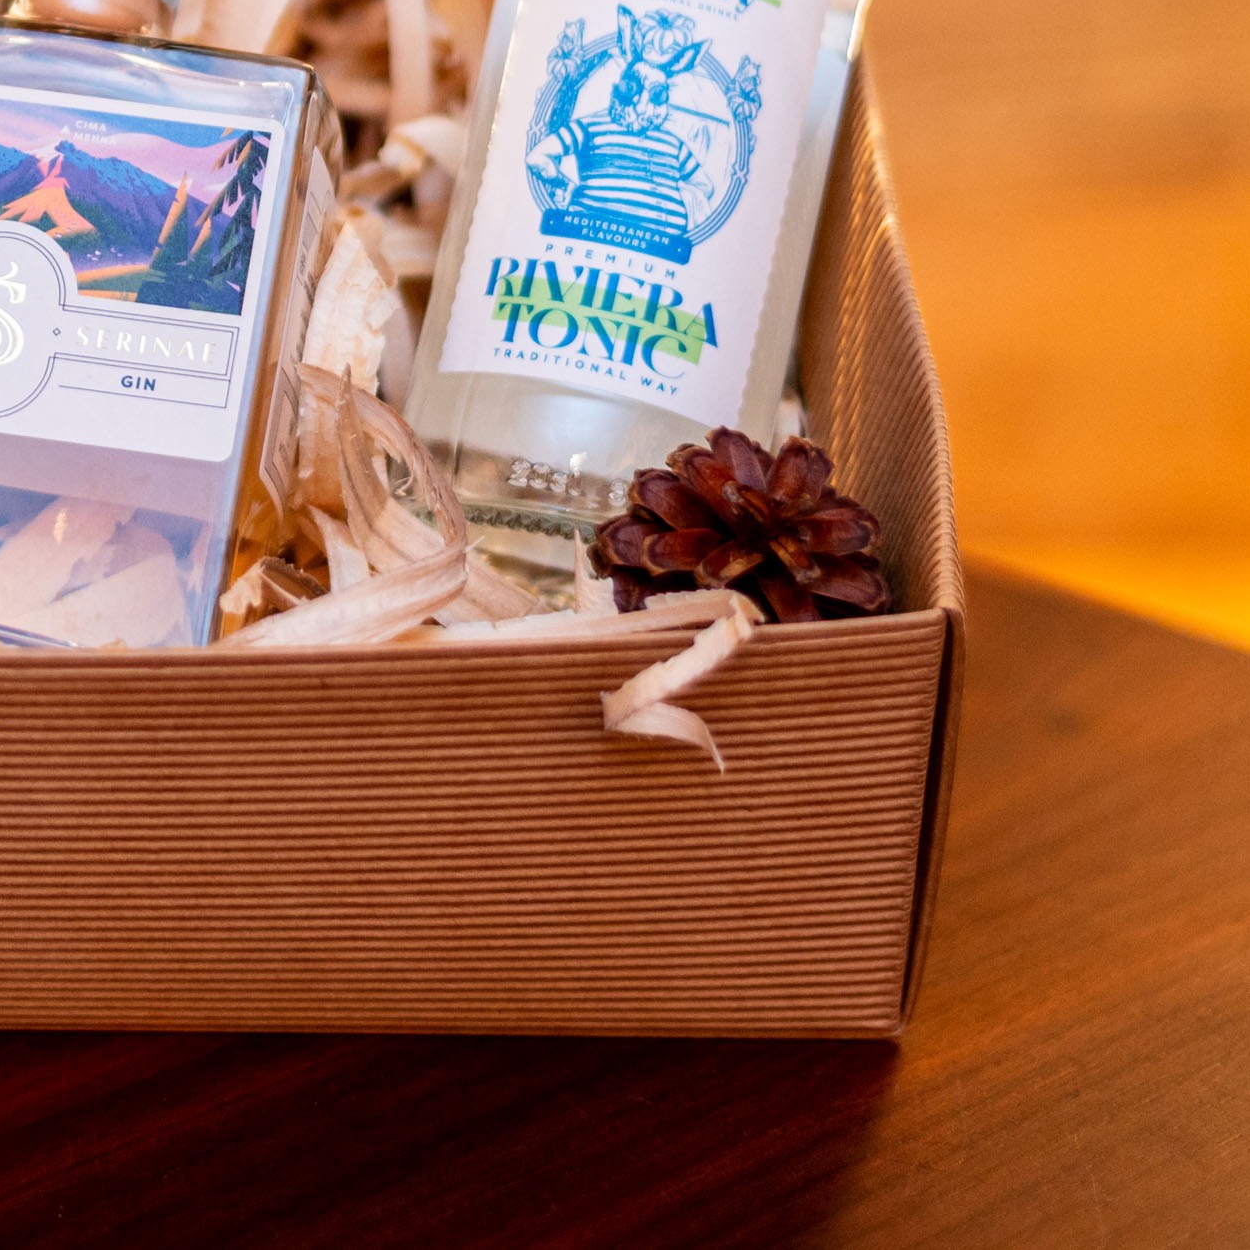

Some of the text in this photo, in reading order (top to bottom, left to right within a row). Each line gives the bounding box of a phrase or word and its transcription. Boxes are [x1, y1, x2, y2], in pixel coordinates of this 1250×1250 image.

[697, 3, 740, 22] DRINKS
[75, 120, 107, 132] CIMA
[563, 215, 670, 245] MEDITERRANEAN
[581, 229, 647, 249] FLAVOURS
[545, 243, 676, 280] PREMIUM
[484, 256, 718, 348] RIVIERA
[77, 325, 216, 364] SERINAE
[498, 302, 687, 380] TONIC
[121, 375, 157, 391] GIN
[493, 348, 678, 396] TRADITIONAL WAY
